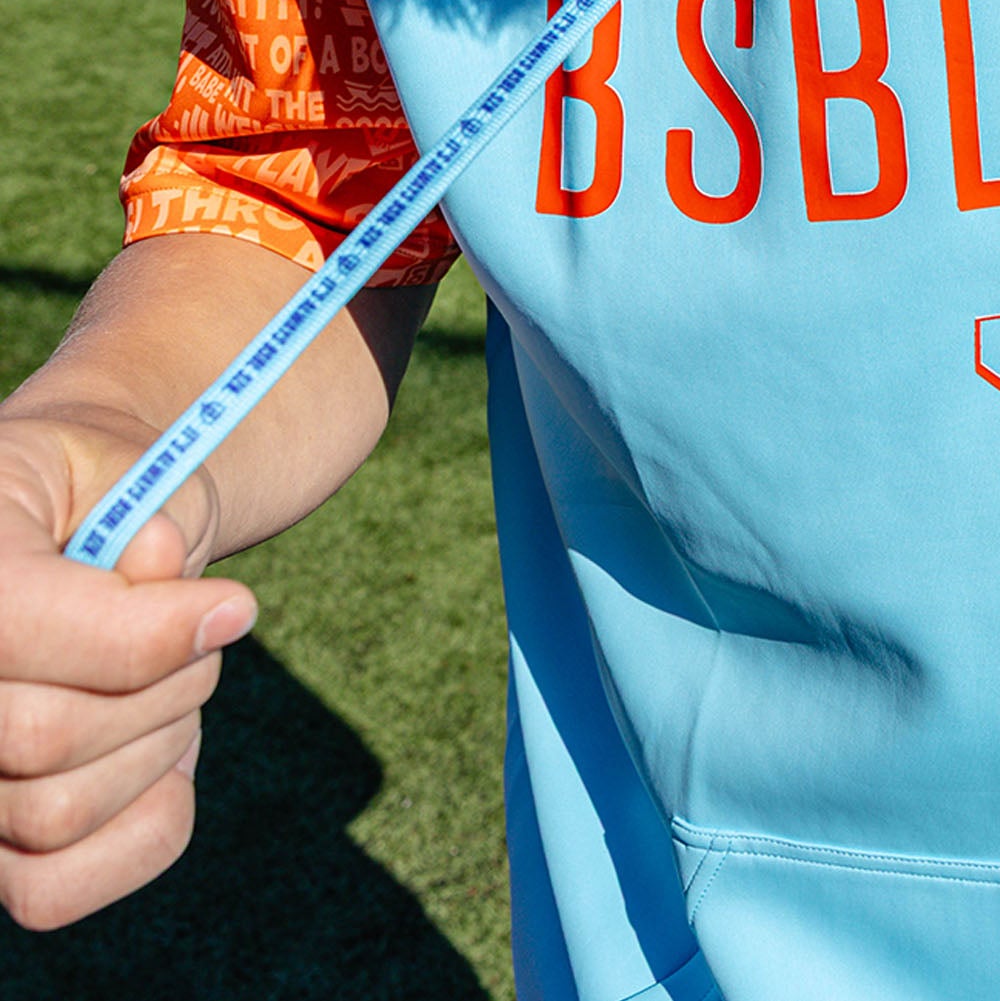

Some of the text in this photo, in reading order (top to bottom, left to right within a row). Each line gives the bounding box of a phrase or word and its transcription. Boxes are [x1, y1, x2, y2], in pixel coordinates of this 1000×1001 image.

[269, 34, 307, 75] OF
[319, 34, 340, 75] A
[188, 65, 226, 104] BABE
[265, 88, 326, 122] THE
